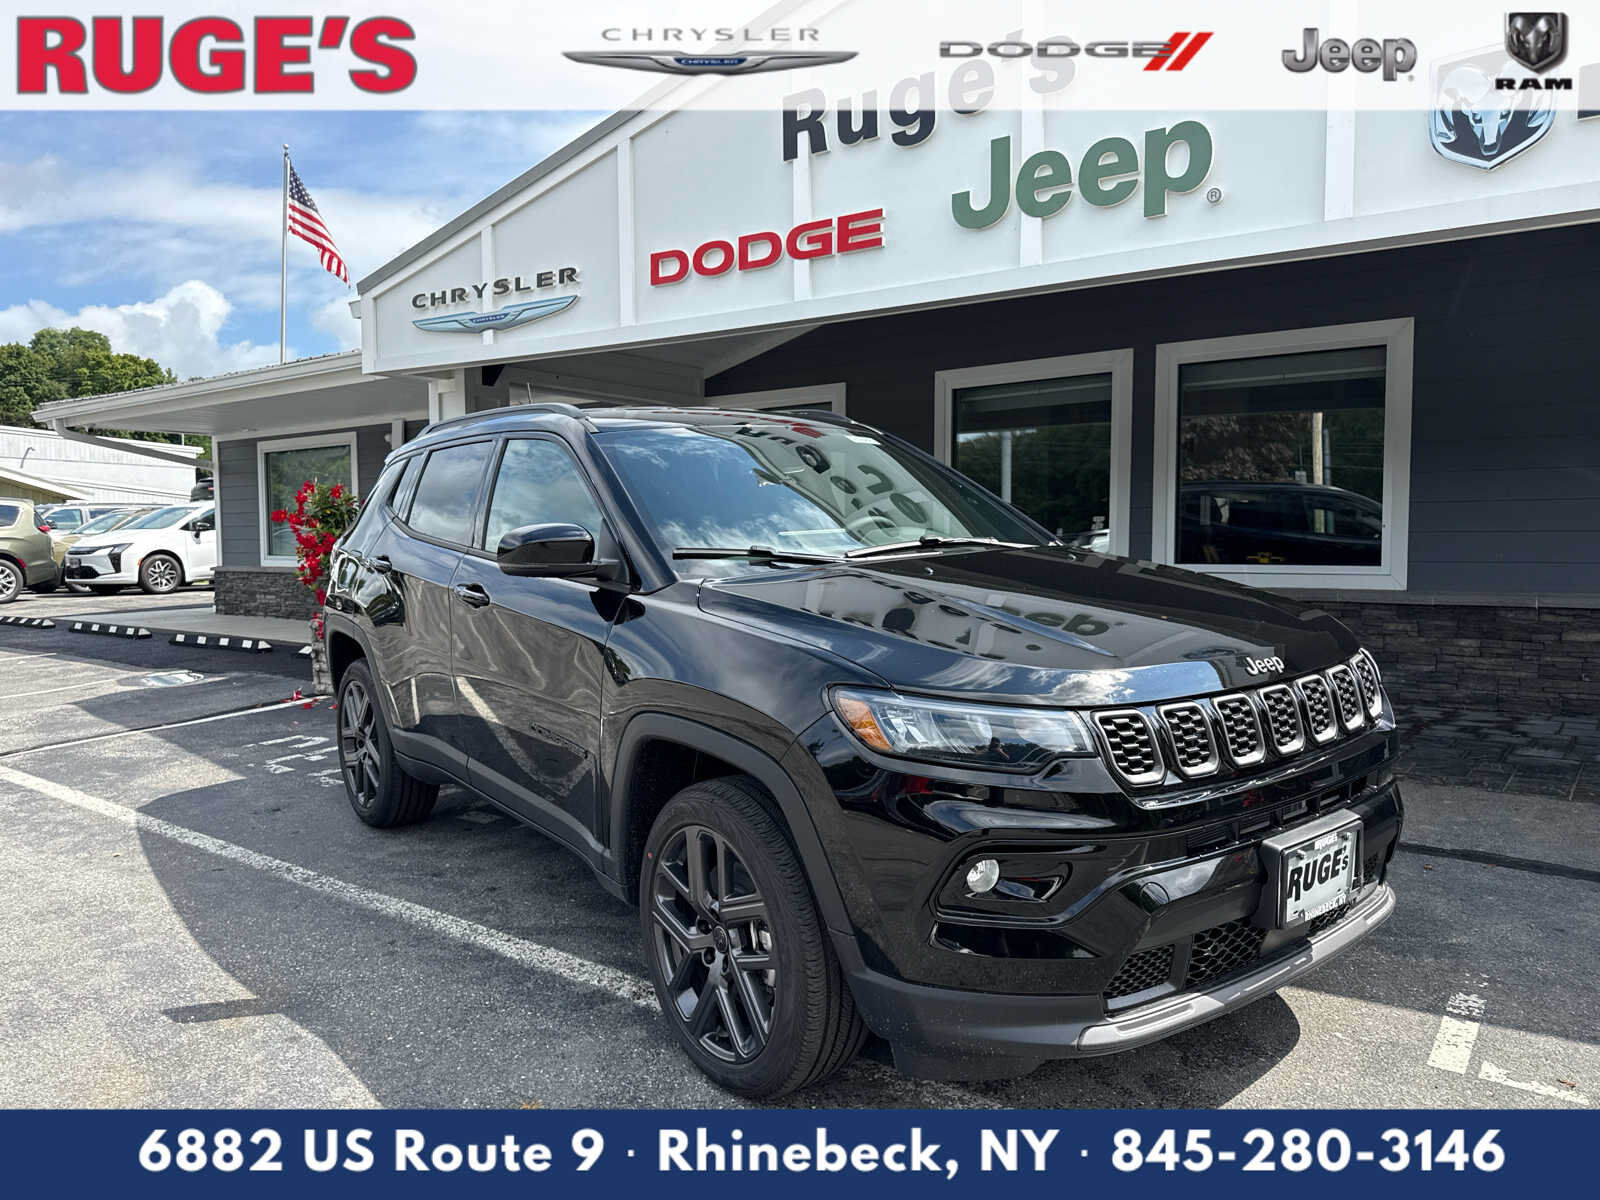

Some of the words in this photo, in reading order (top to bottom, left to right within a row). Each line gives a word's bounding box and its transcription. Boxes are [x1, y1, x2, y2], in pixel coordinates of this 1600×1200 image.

[952, 120, 1213, 229] Jeep
[651, 208, 883, 286] DODGE
[412, 267, 578, 308] CHRYSLER
[1245, 656, 1285, 675] Jeep
